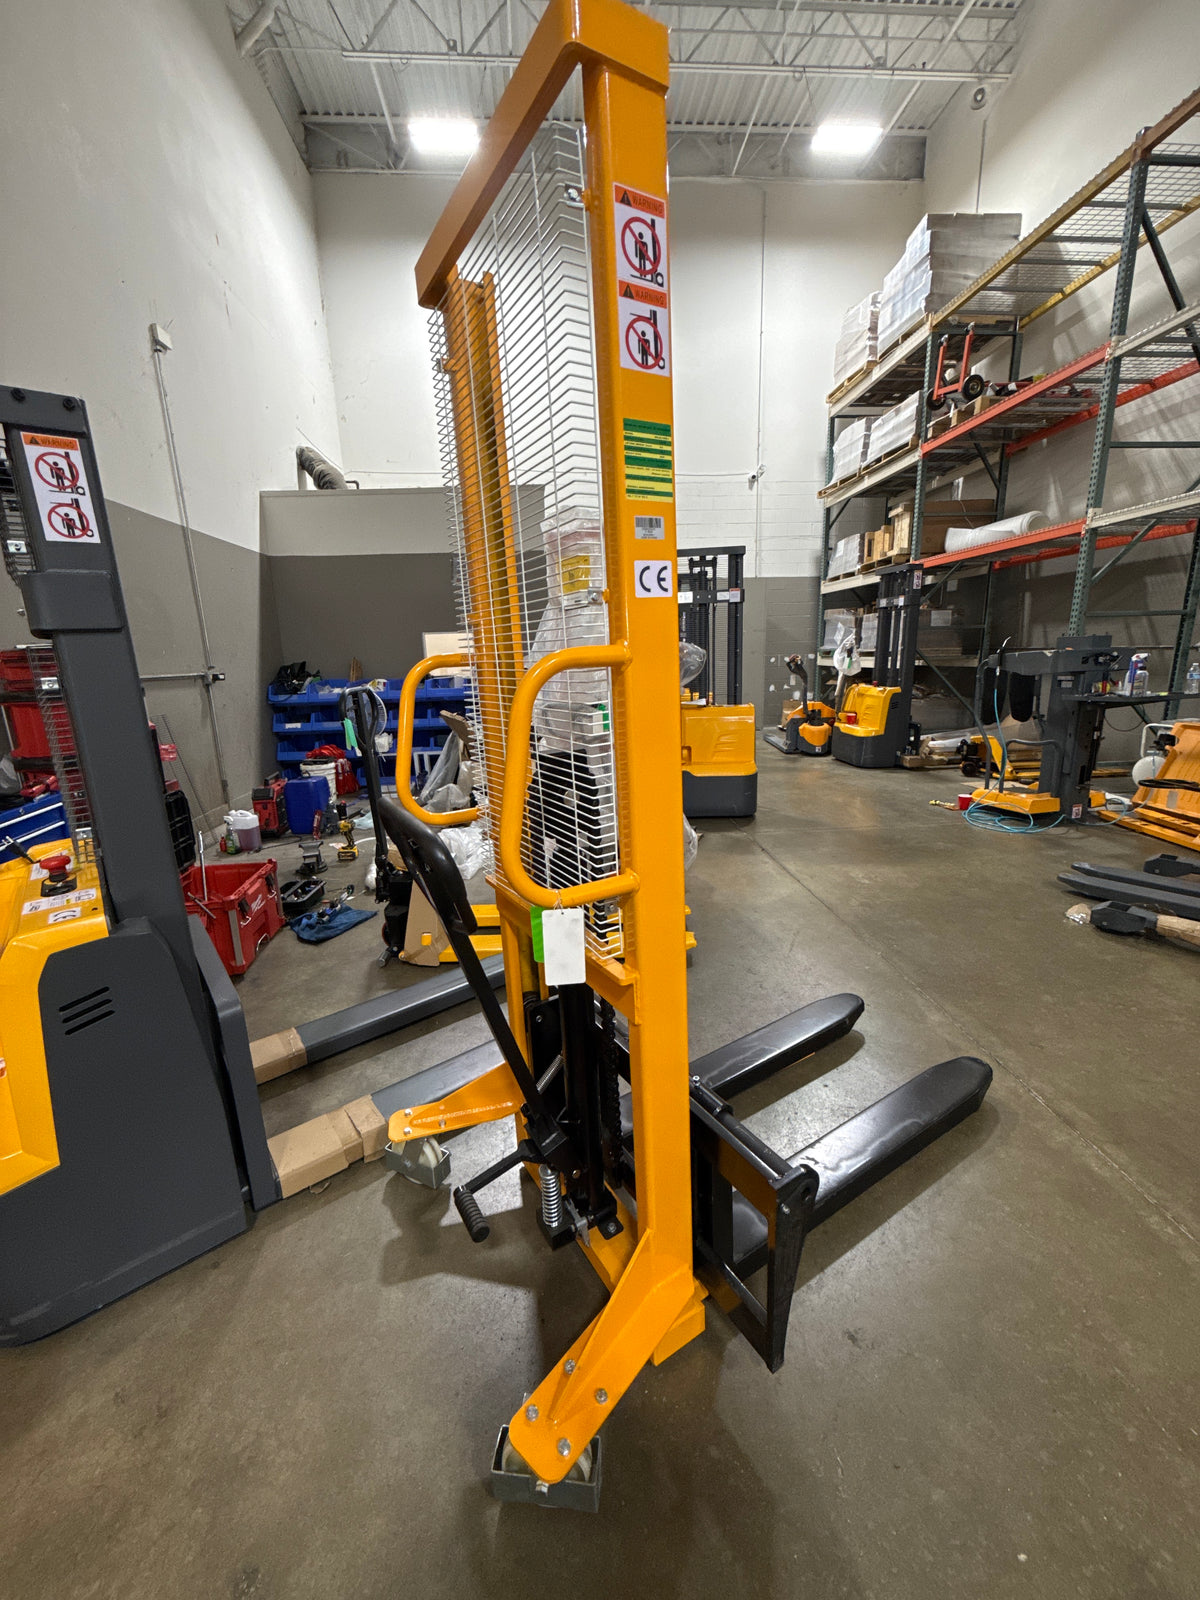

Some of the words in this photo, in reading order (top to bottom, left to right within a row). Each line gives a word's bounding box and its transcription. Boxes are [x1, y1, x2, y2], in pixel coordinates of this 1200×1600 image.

[632, 195, 662, 213] WARNING
[635, 290, 664, 305] WARNING
[40, 439, 74, 449] WARNING
[639, 565, 668, 592] CE
